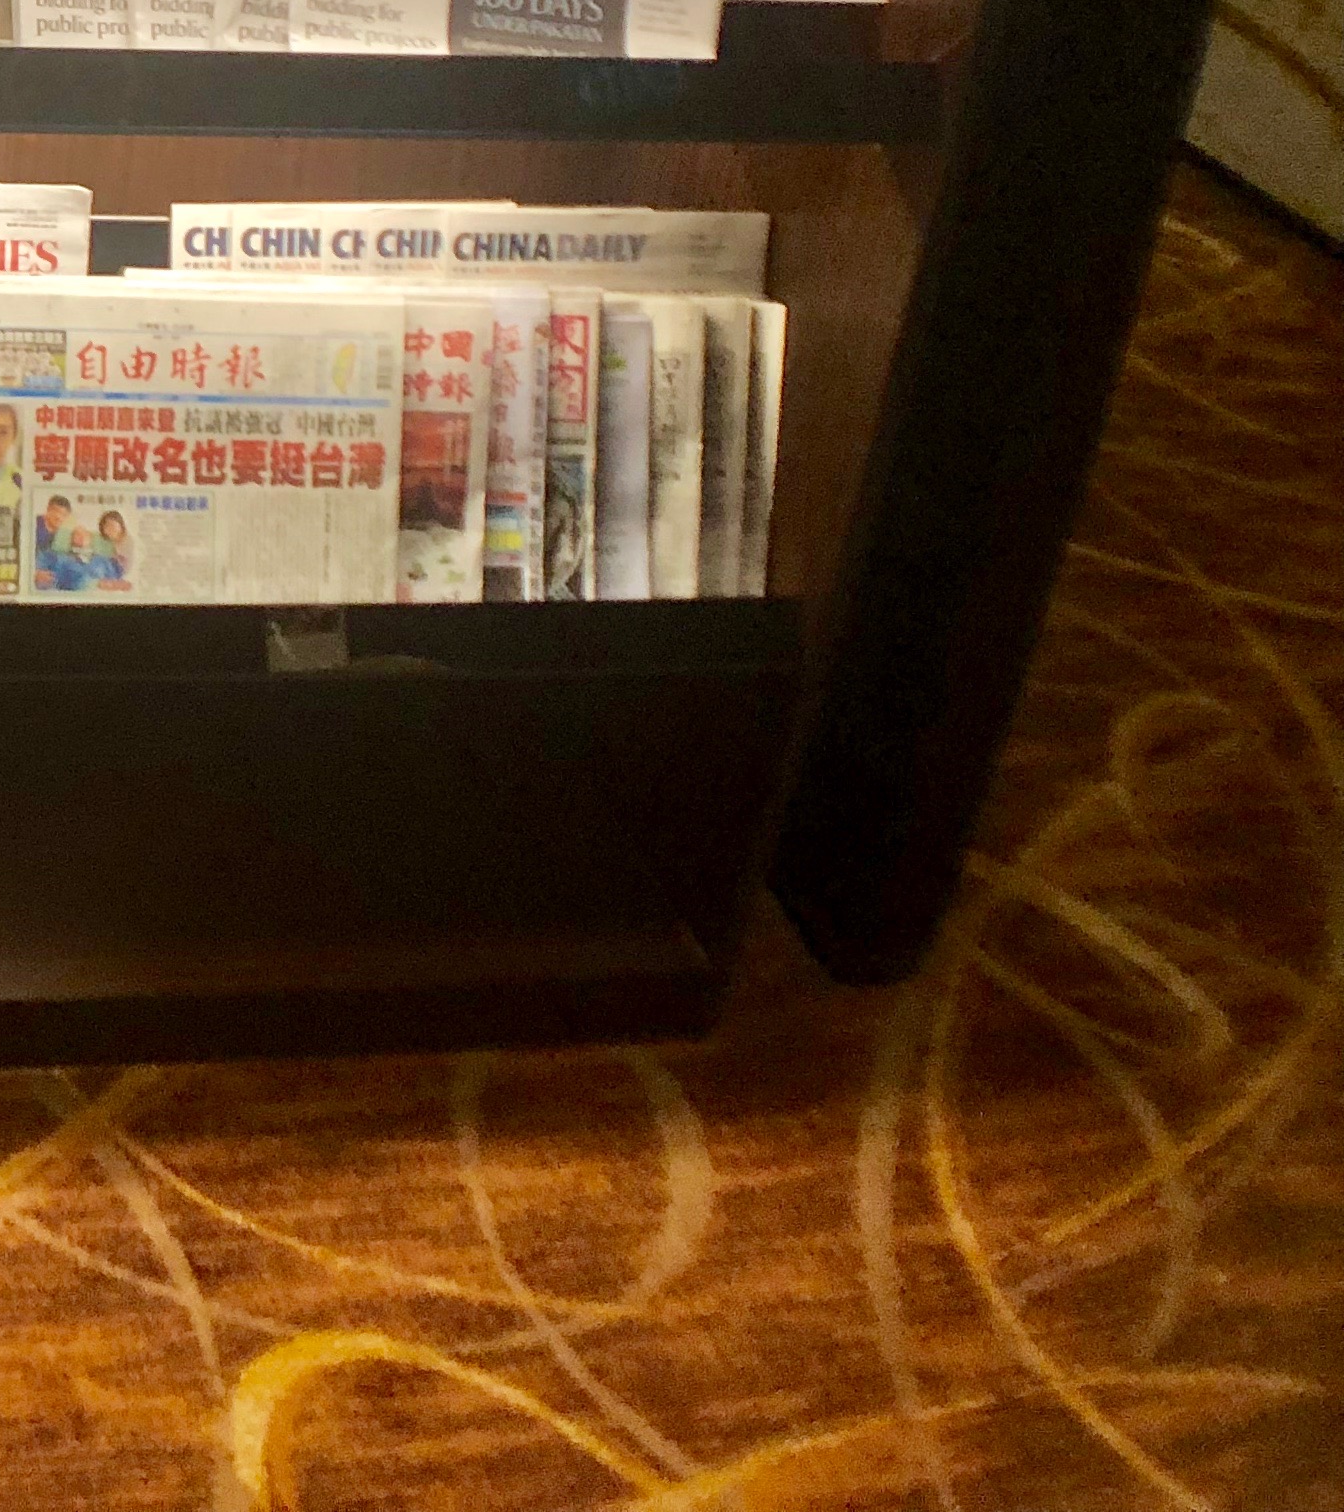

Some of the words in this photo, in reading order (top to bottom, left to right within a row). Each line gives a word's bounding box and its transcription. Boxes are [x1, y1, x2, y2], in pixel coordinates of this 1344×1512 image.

[35, 16, 93, 36] public
[150, 19, 209, 41] public
[452, 231, 554, 263] CHINA
[556, 232, 648, 263] DAILY
[76, 340, 266, 390] 自由時報
[32, 433, 387, 491] 寧願改名也要挺台灣
